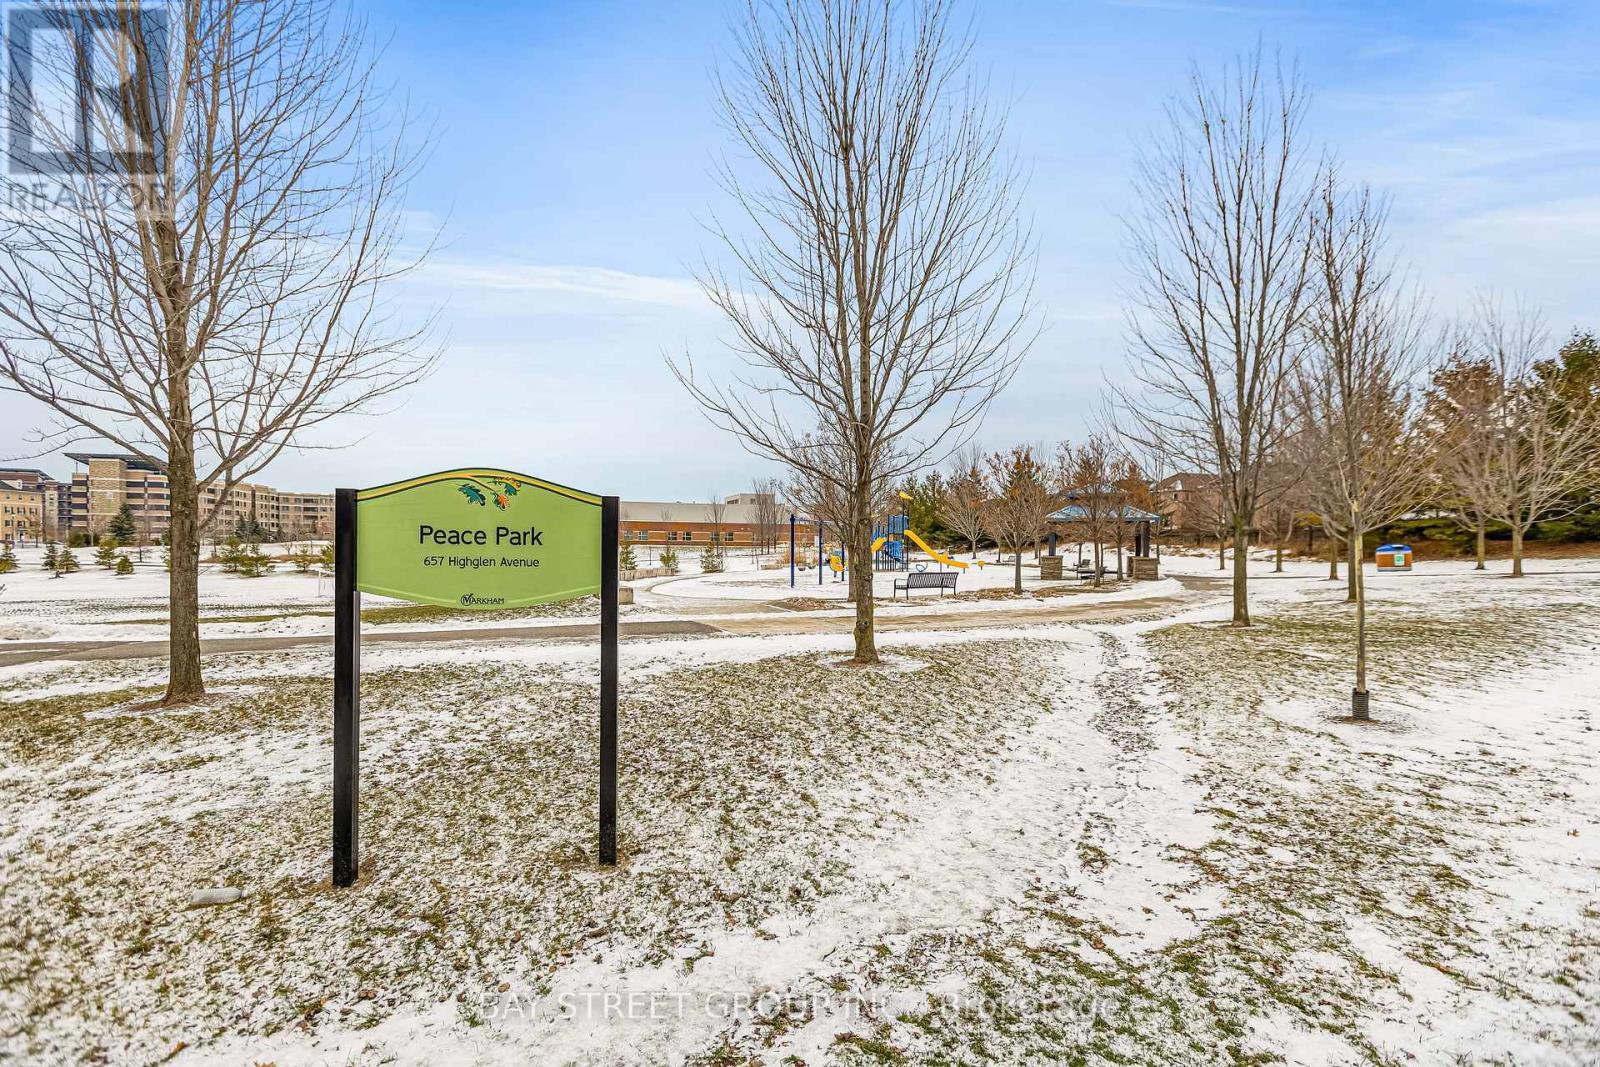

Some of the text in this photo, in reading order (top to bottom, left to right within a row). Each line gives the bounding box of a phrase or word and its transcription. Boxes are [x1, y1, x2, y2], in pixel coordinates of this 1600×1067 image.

[419, 525, 543, 546] Peace Park
[423, 556, 540, 569] 657 Highglen Avenue
[460, 593, 505, 606] MARKHAM
